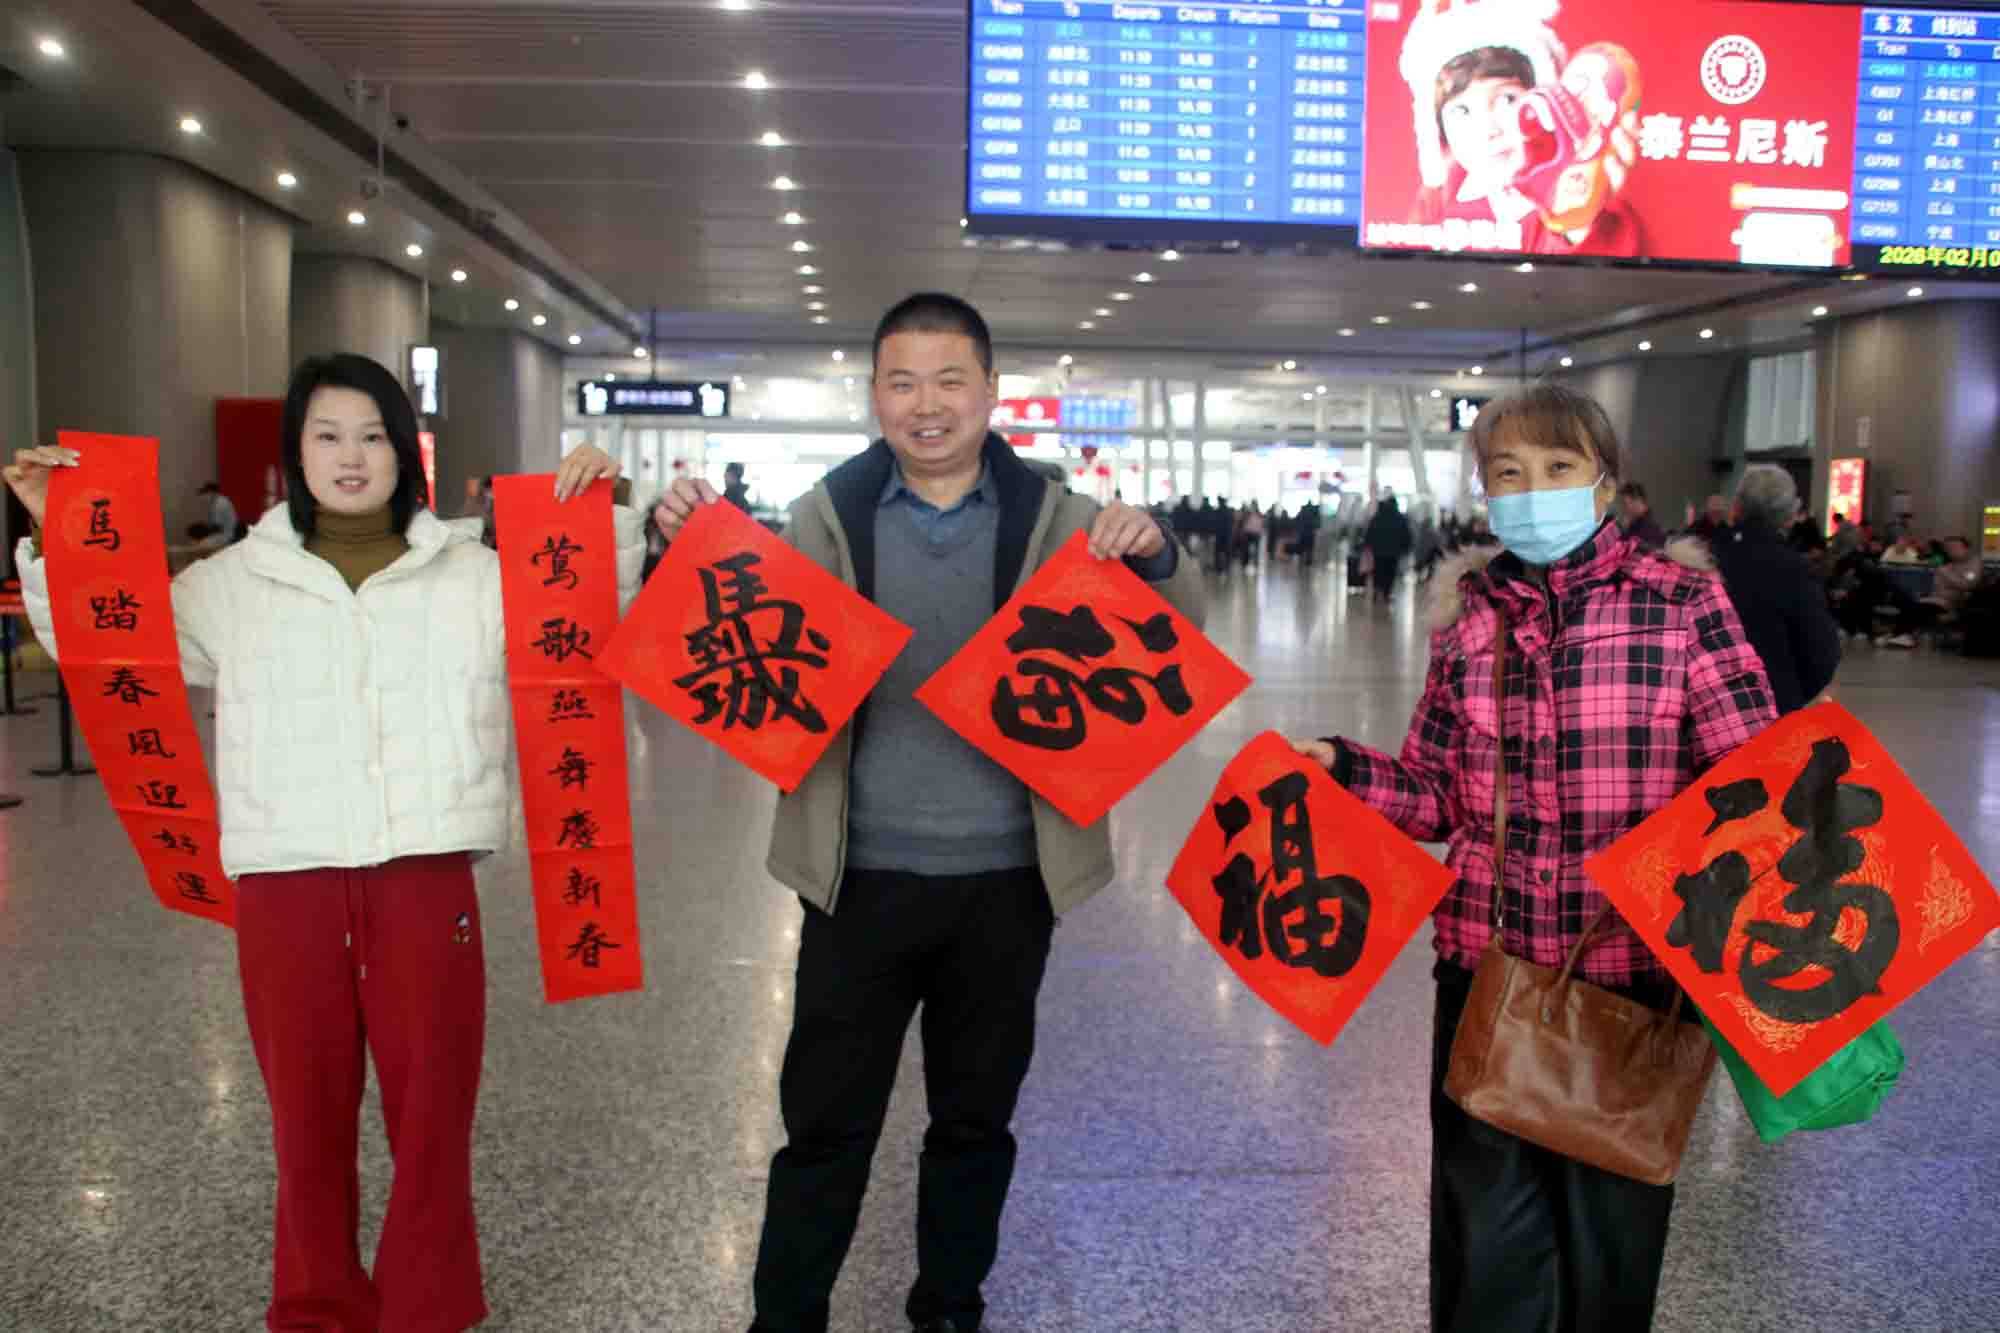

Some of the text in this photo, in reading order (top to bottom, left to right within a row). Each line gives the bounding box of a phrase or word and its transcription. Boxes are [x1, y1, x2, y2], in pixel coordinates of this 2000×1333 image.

[1639, 113, 1829, 168] 泰兰尼斯
[1211, 770, 1373, 978] 福
